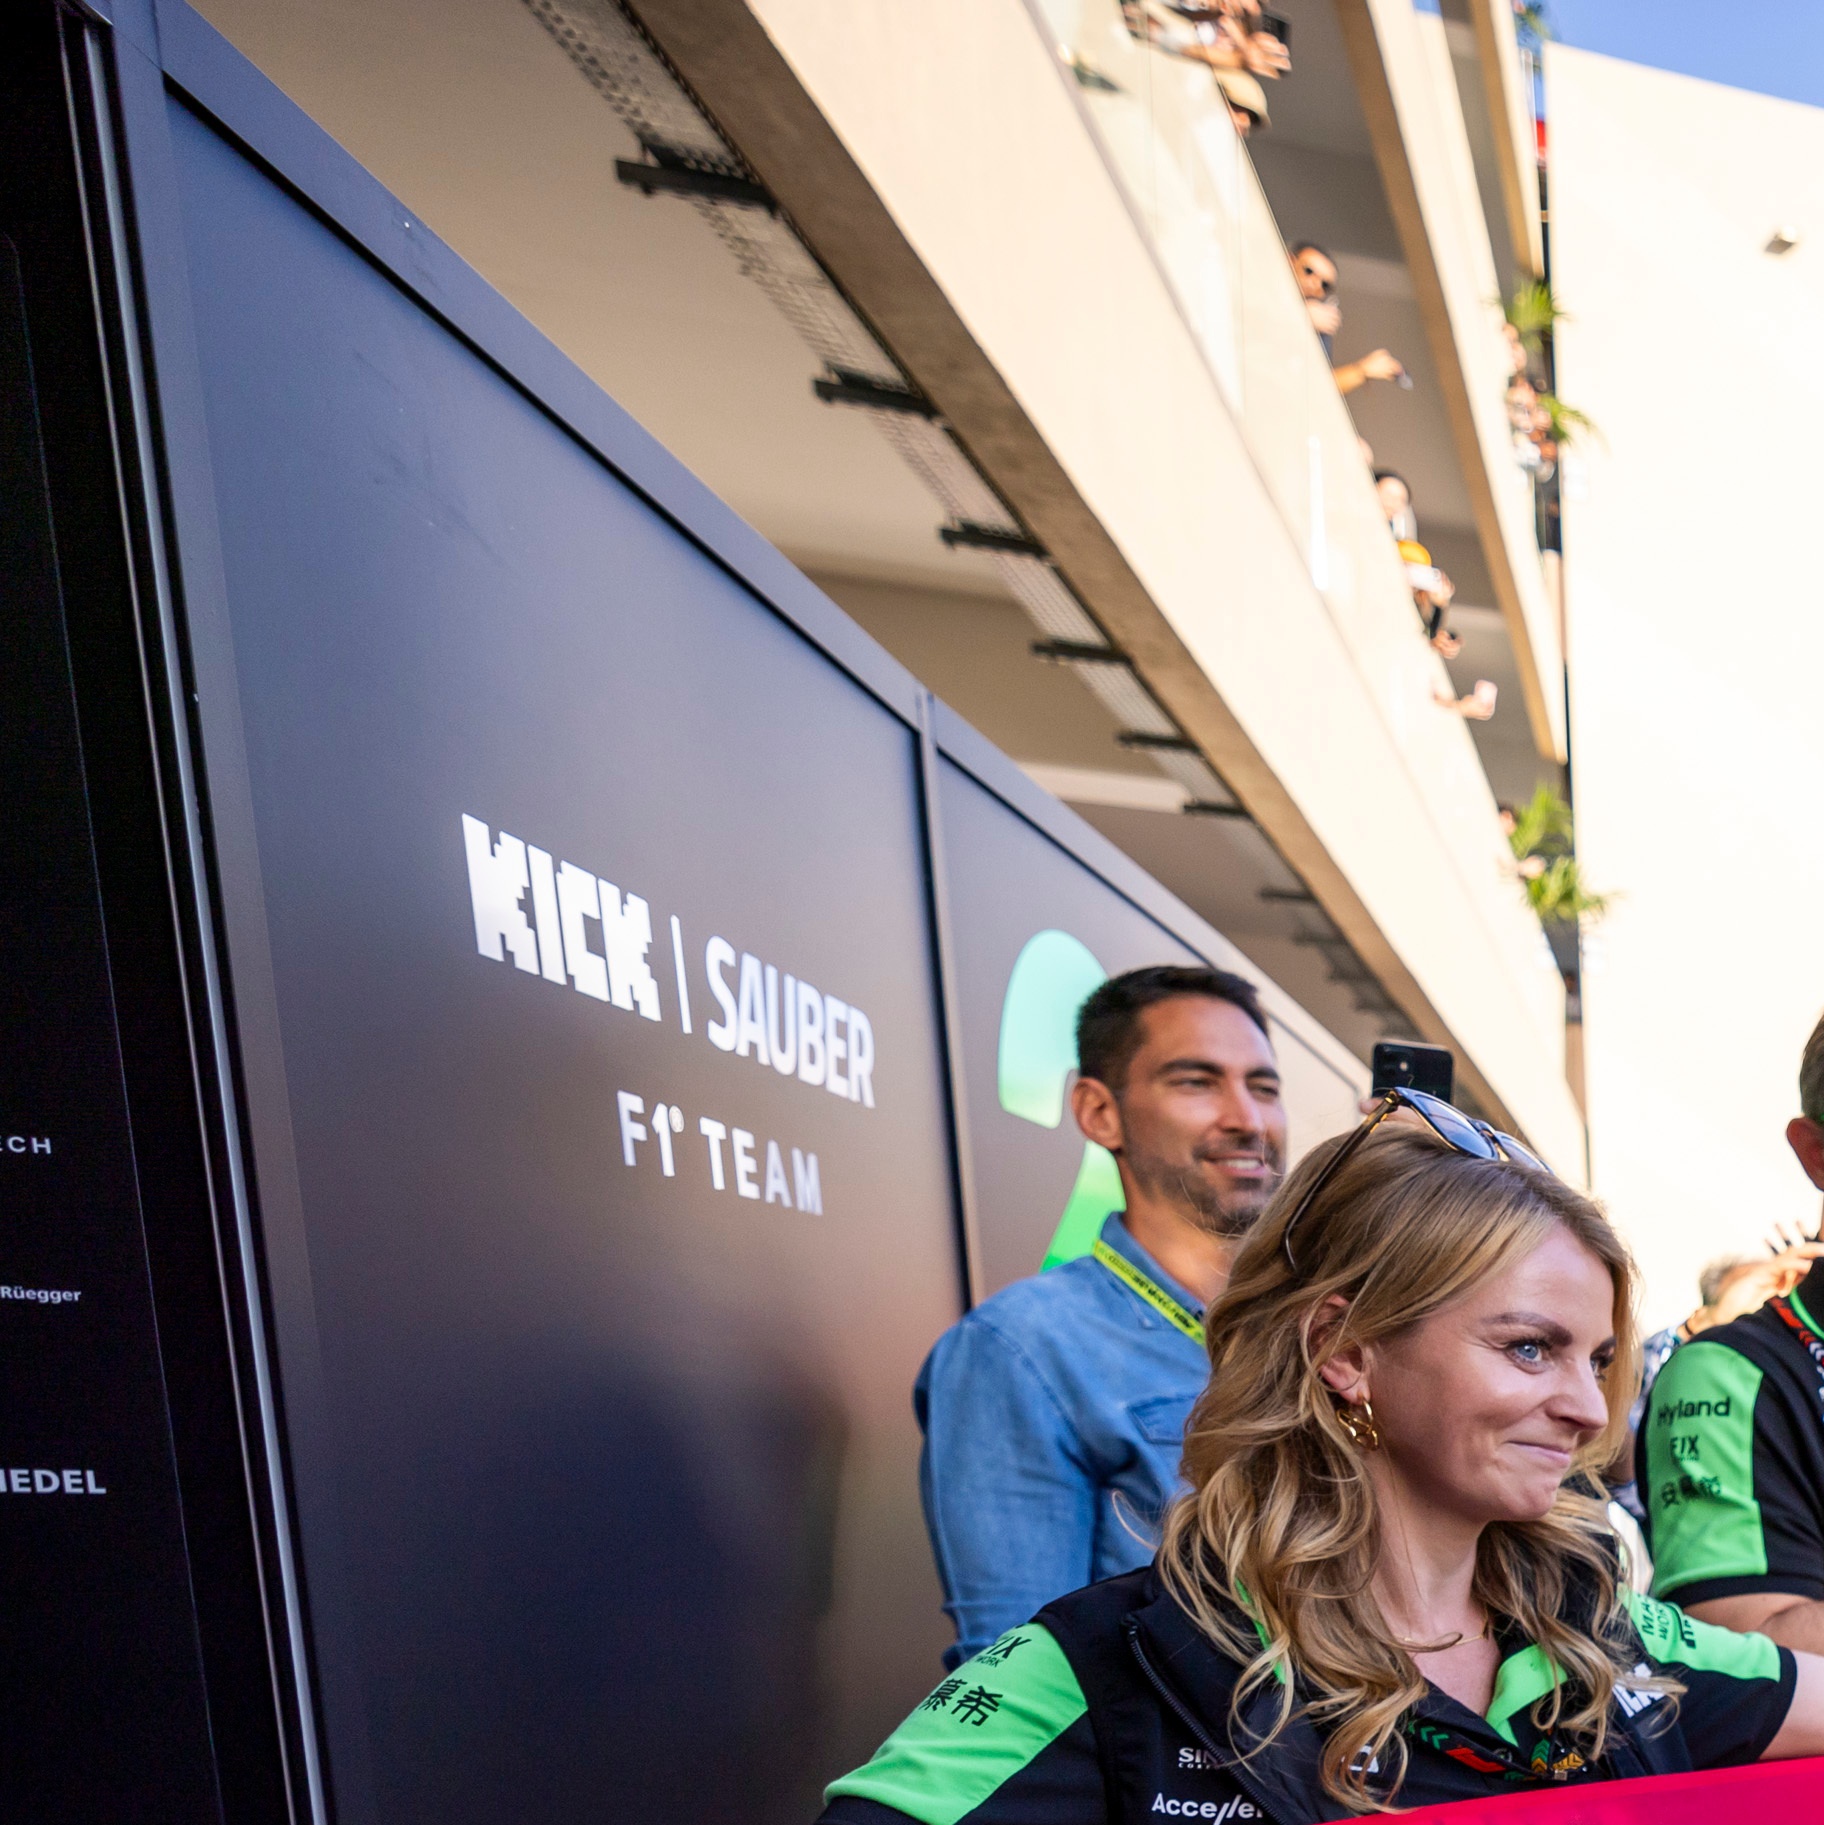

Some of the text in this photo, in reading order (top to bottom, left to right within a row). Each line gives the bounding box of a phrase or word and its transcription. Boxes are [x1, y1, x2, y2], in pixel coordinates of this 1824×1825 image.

[462, 813, 876, 1108] KICK SAUBER
[0, 1136, 53, 1155] CH
[700, 1116, 823, 1216] TEAM
[0, 1284, 82, 1303] Rüegger
